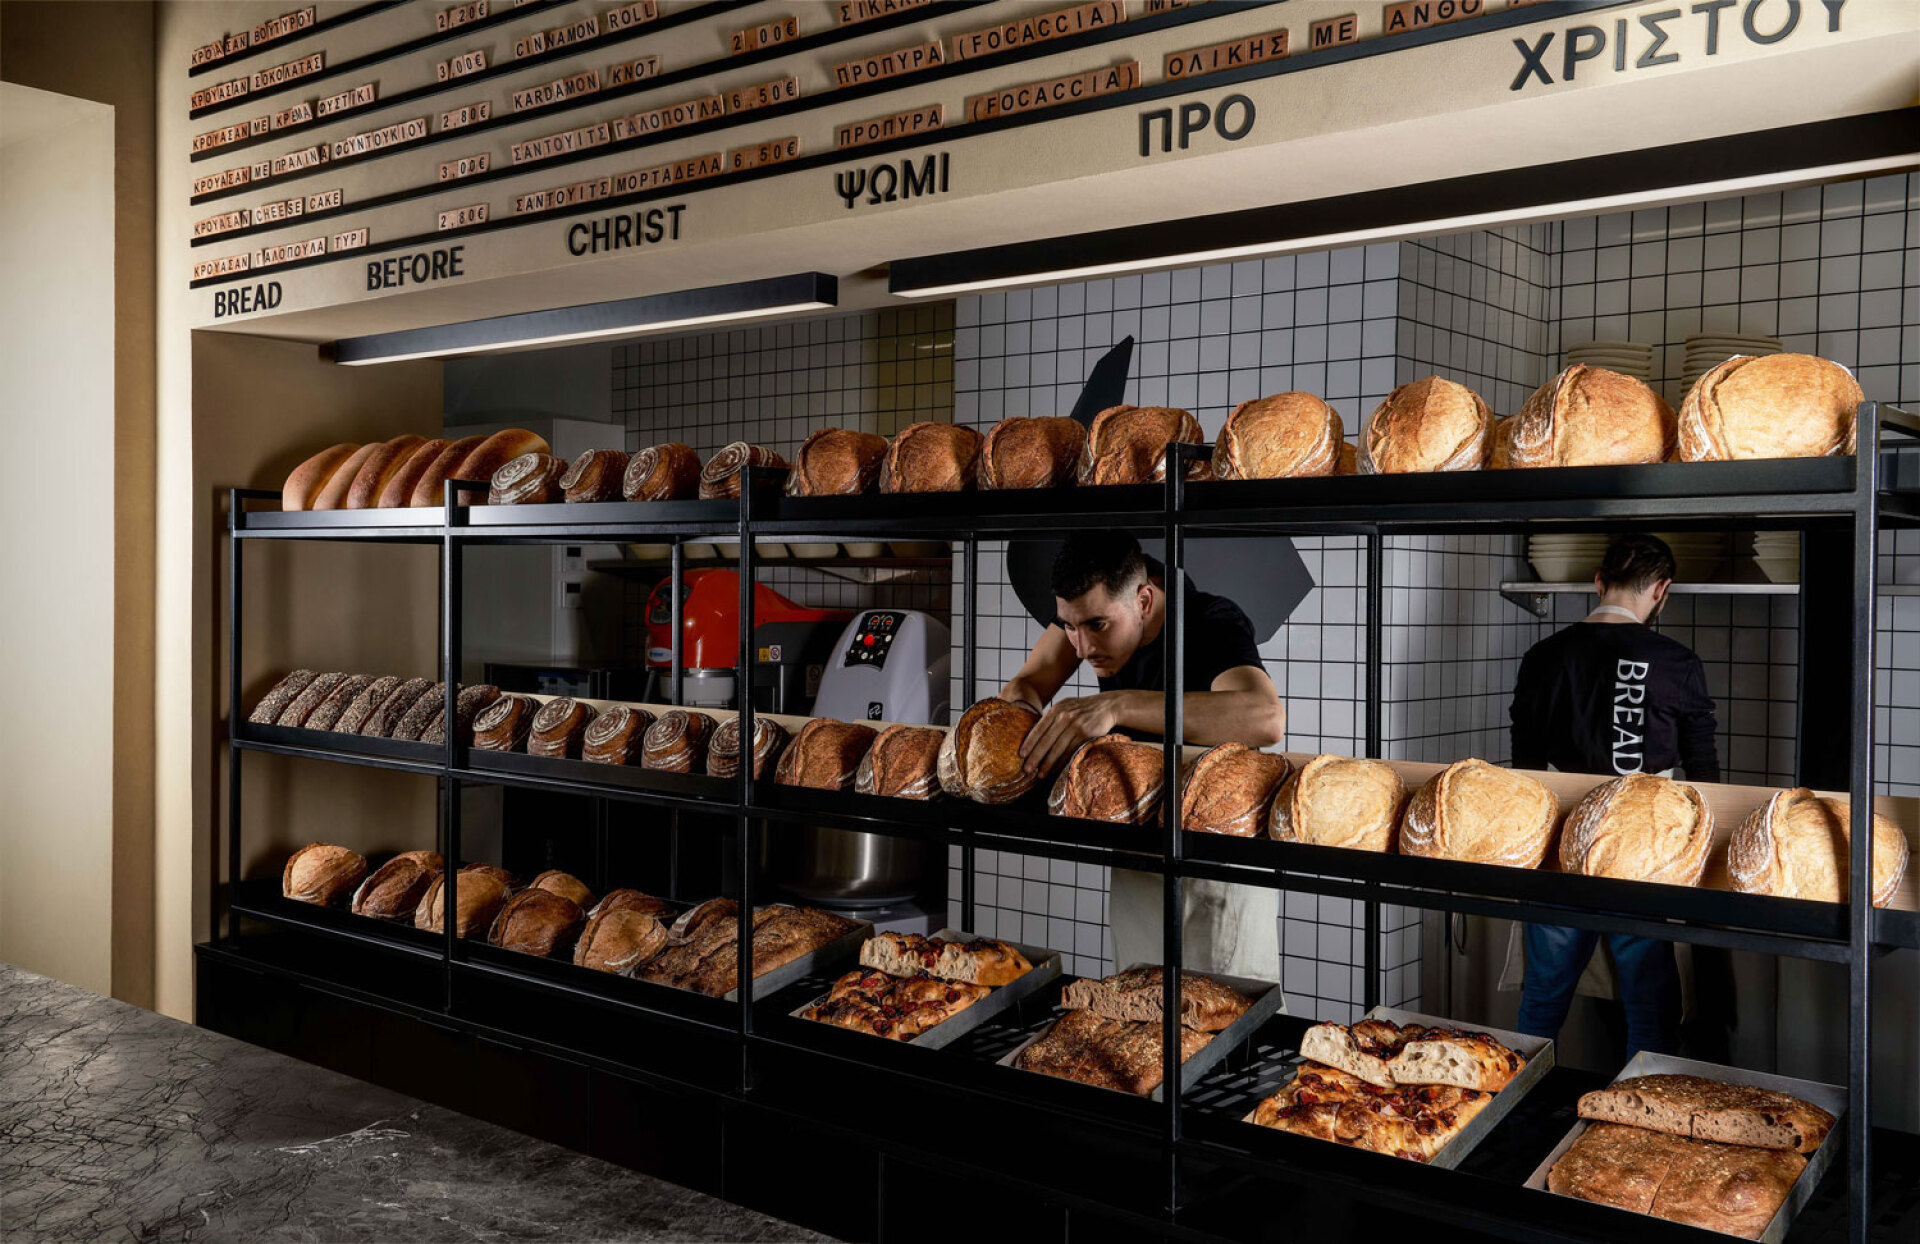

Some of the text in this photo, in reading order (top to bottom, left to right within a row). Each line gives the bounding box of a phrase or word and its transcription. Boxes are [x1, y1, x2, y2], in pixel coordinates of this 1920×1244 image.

[254, 10, 312, 42] ΒΟΥΤΥΡΟΥ
[516, 2, 654, 57] CINNAMON ROLL
[837, 46, 941, 84] ΠΡΟΠΥΡΑ
[959, 2, 1118, 61] (FOCACCIA)
[191, 81, 247, 108] ΚΡΟΥΑΣΑΝ
[255, 57, 320, 88] ΣΟΚΟΛΑΤΑΣ
[514, 74, 596, 109] KARDAMON
[612, 60, 657, 84] KNOT
[836, 0, 1852, 208] ΨΩΜΙ ΠΡΟ ΧΡΙΣΤΟΥ
[840, 110, 939, 146] ΠΡΟΠΥΡΑ
[973, 66, 1133, 122] (FOCACCIA)
[1169, 34, 1284, 76] ΟΛΙΚΗΣ
[1315, 20, 1353, 47] ΜΕ
[193, 125, 248, 151] ΚΡΟΥΑΣΑΝ
[254, 119, 267, 133] ΜΕ
[319, 87, 370, 114] ΦΥΣΤΙΚΙ
[513, 126, 607, 161] ΣΑΝΤΟΥΙΤΣ
[615, 99, 721, 137] ΓΑΛΟΠΟΥΛΑ
[194, 169, 248, 194] ΚΡΟΥΑΣΑΝ
[254, 164, 268, 177] ΜΕ
[275, 149, 327, 171] ΠΡΑΛΙΝΑ
[335, 121, 424, 156] ΦΟΥΝΤΟΥΚΙΟΥ
[516, 181, 608, 211] ΣΑΝΤΟΥΙΤΣ
[616, 158, 720, 192] ΜΟΡΤΑΔΕΛΑ
[194, 213, 249, 235] ΚΡΟΥΑΣΑΝ
[256, 202, 301, 222] CHEESE
[309, 192, 339, 210] CAKE
[194, 255, 248, 278] ΚΡΟΥΑΣΑΝ
[256, 241, 323, 266] ΓΑΛΟΠΟΥΛΑ
[335, 232, 364, 249] ΤΥΡΙ
[214, 204, 687, 318] BREAD BEFORE CHRIST
[1612, 658, 1650, 775] BREAD
